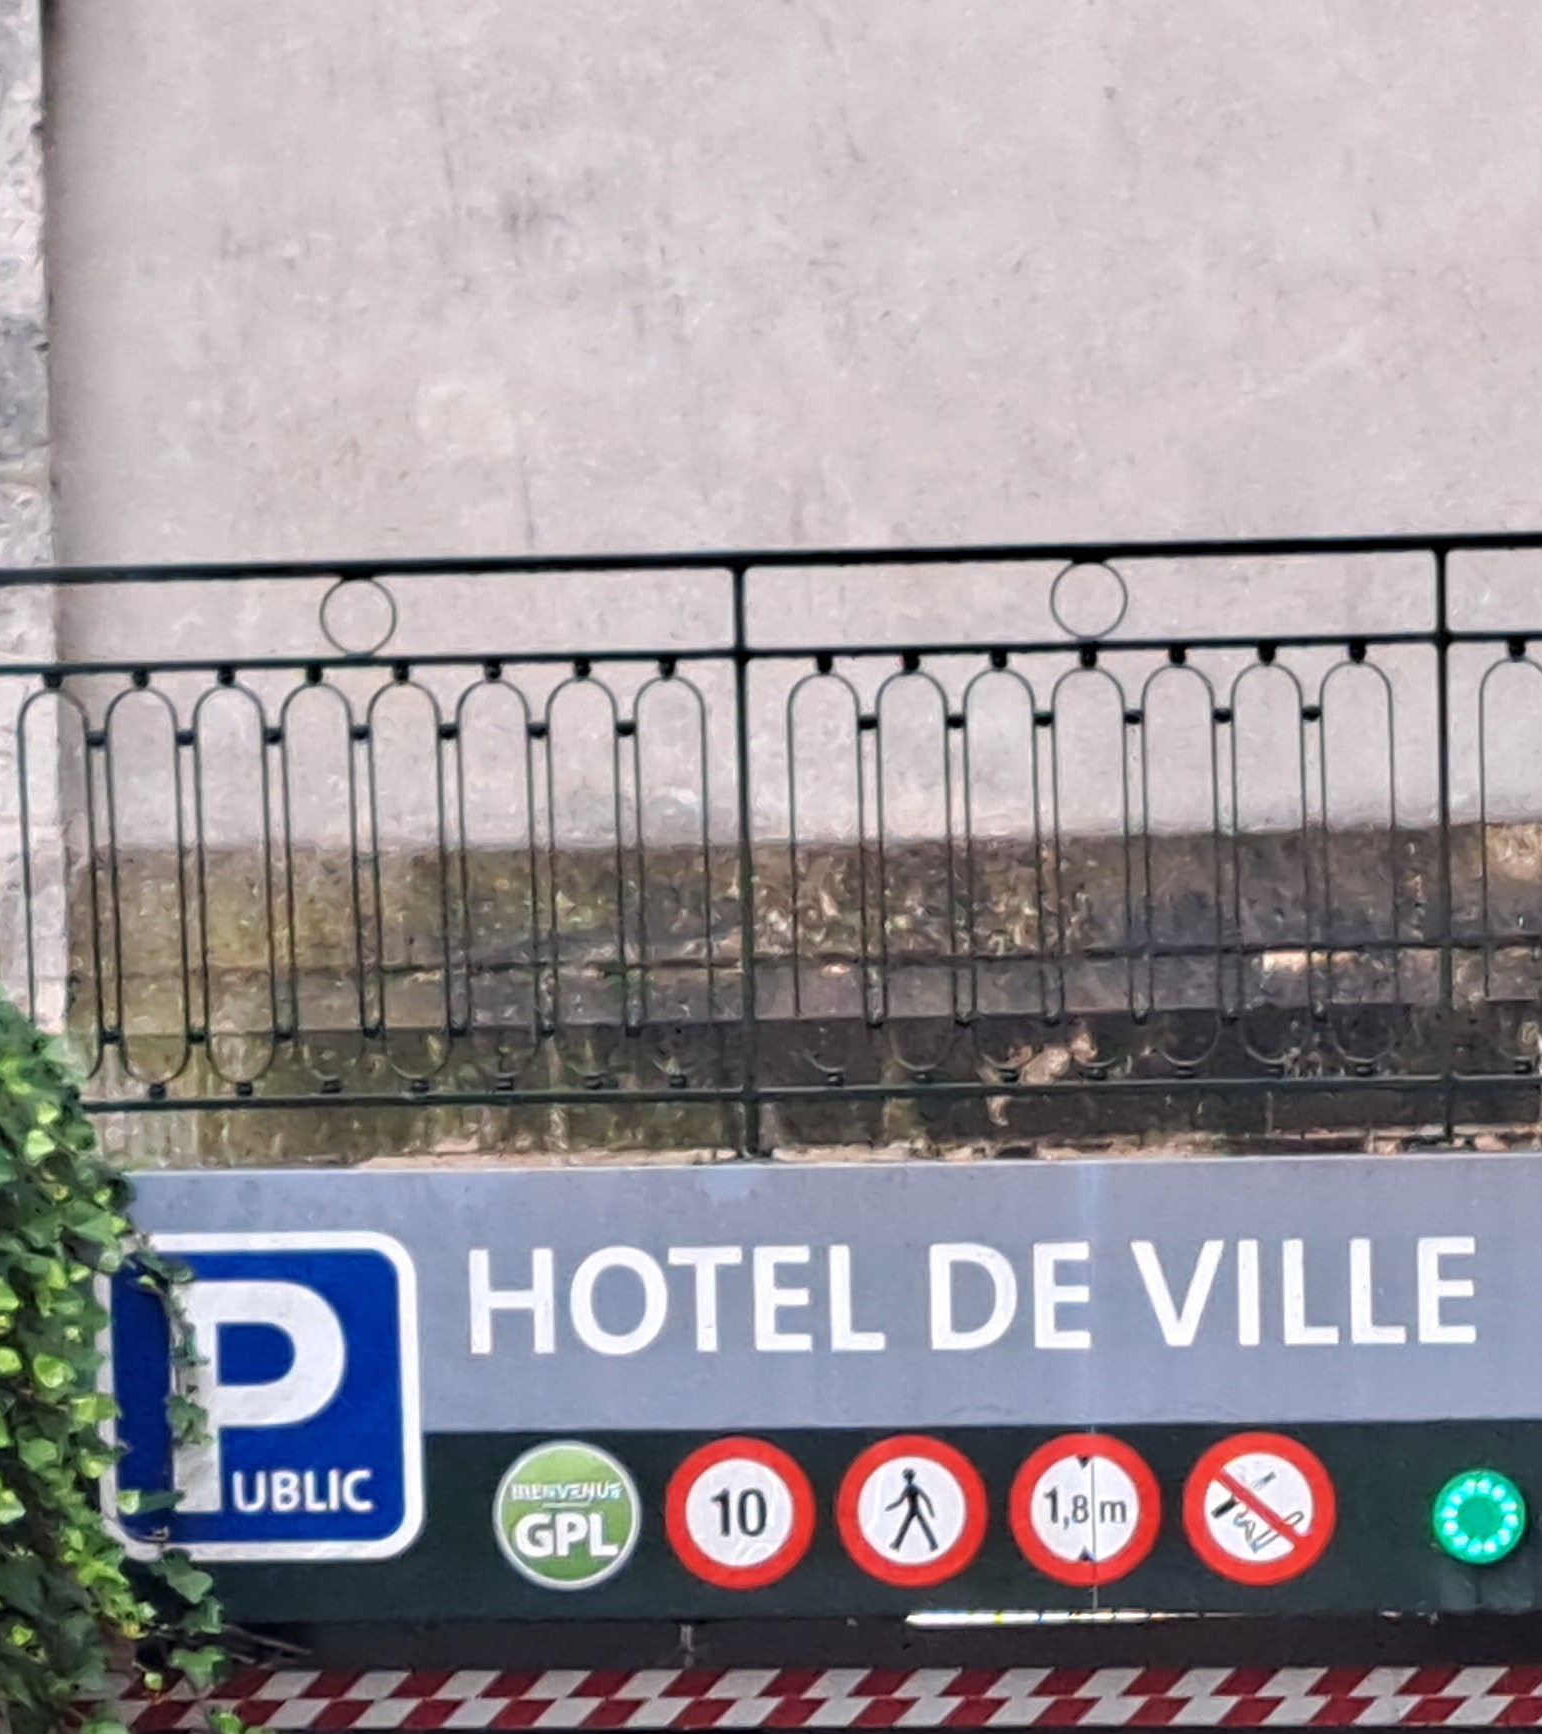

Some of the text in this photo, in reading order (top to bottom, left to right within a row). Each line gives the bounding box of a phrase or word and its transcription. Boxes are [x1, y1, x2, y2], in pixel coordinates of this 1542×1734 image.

[468, 1237, 1477, 1355] HOTEL DE VILLE
[511, 1479, 623, 1501] BIENVENUE
[709, 1487, 768, 1537] 10
[515, 1511, 619, 1558] GPL
